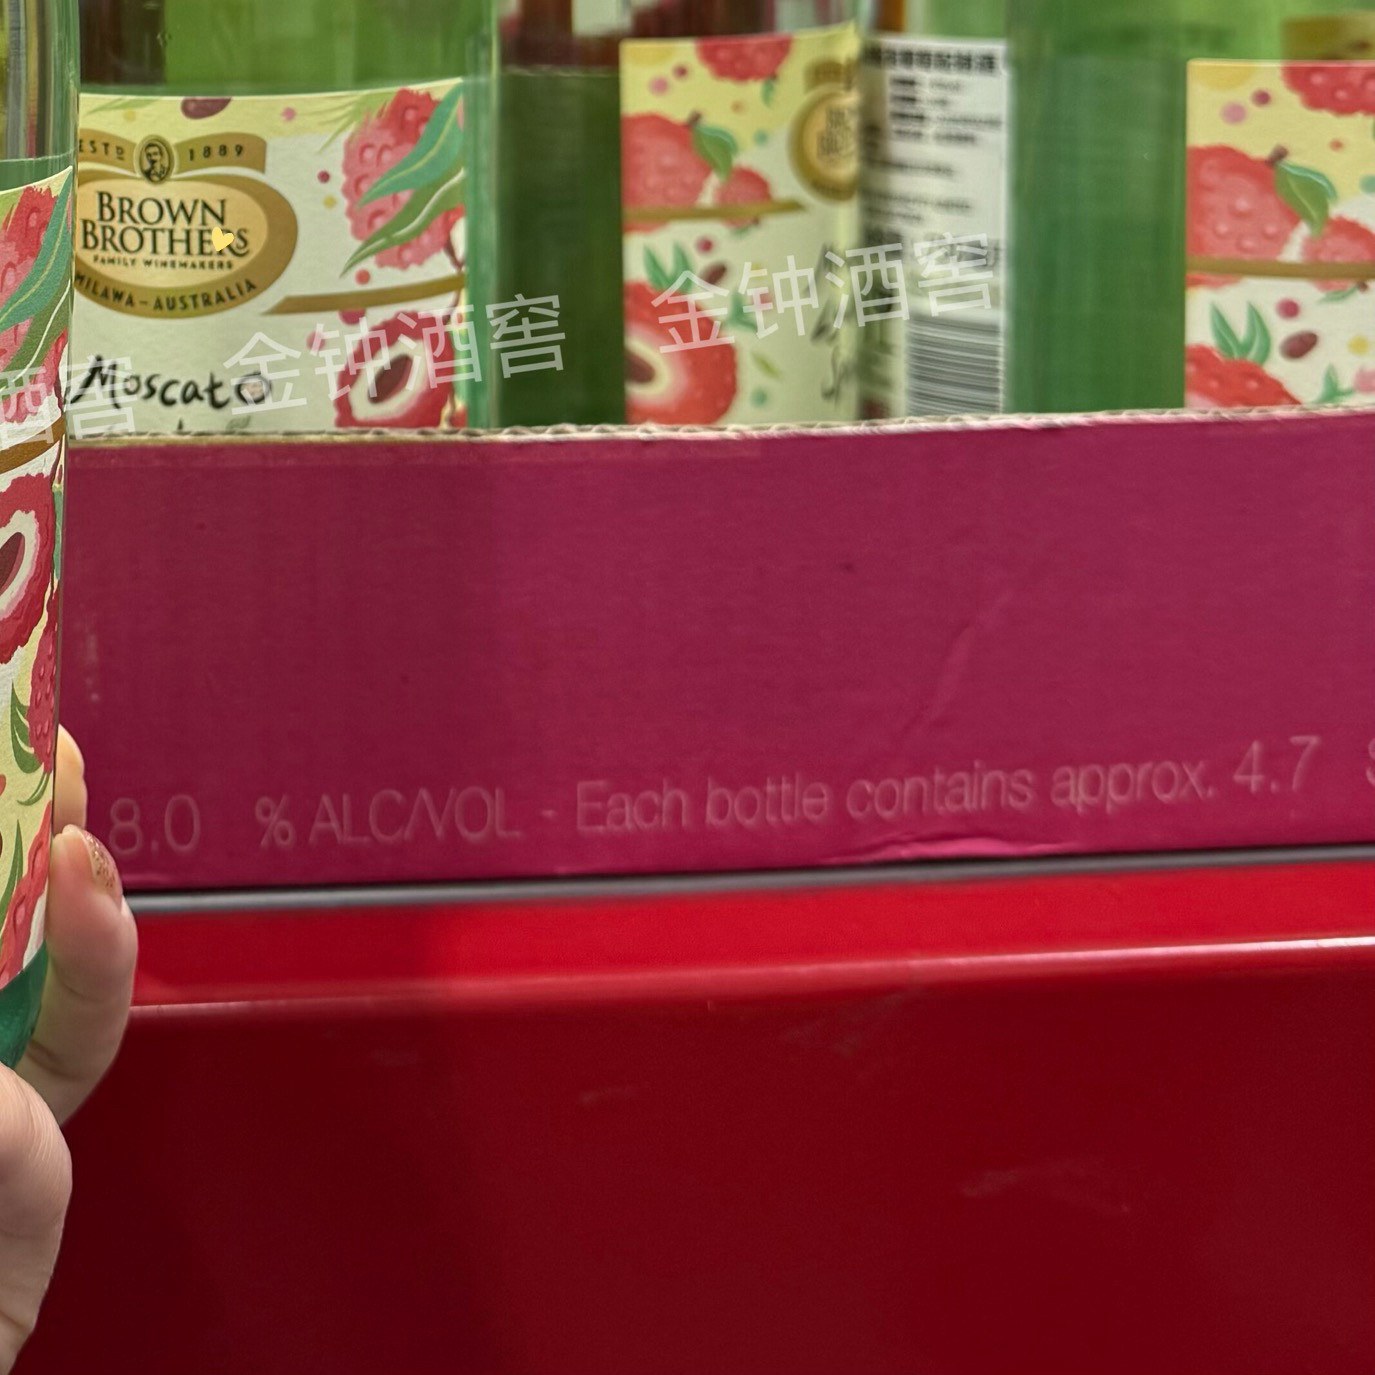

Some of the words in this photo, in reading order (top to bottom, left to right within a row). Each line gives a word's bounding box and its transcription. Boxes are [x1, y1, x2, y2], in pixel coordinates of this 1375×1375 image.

[188, 143, 244, 162] 1889
[96, 190, 227, 227] BROWN
[65, 354, 272, 411] Moscato
[108, 794, 201, 856] 8.0
[576, 776, 688, 835] Each
[705, 772, 831, 827] bottle
[846, 759, 1034, 821] contains
[1051, 759, 1218, 815] approx.
[1232, 734, 1322, 795] 4.7
